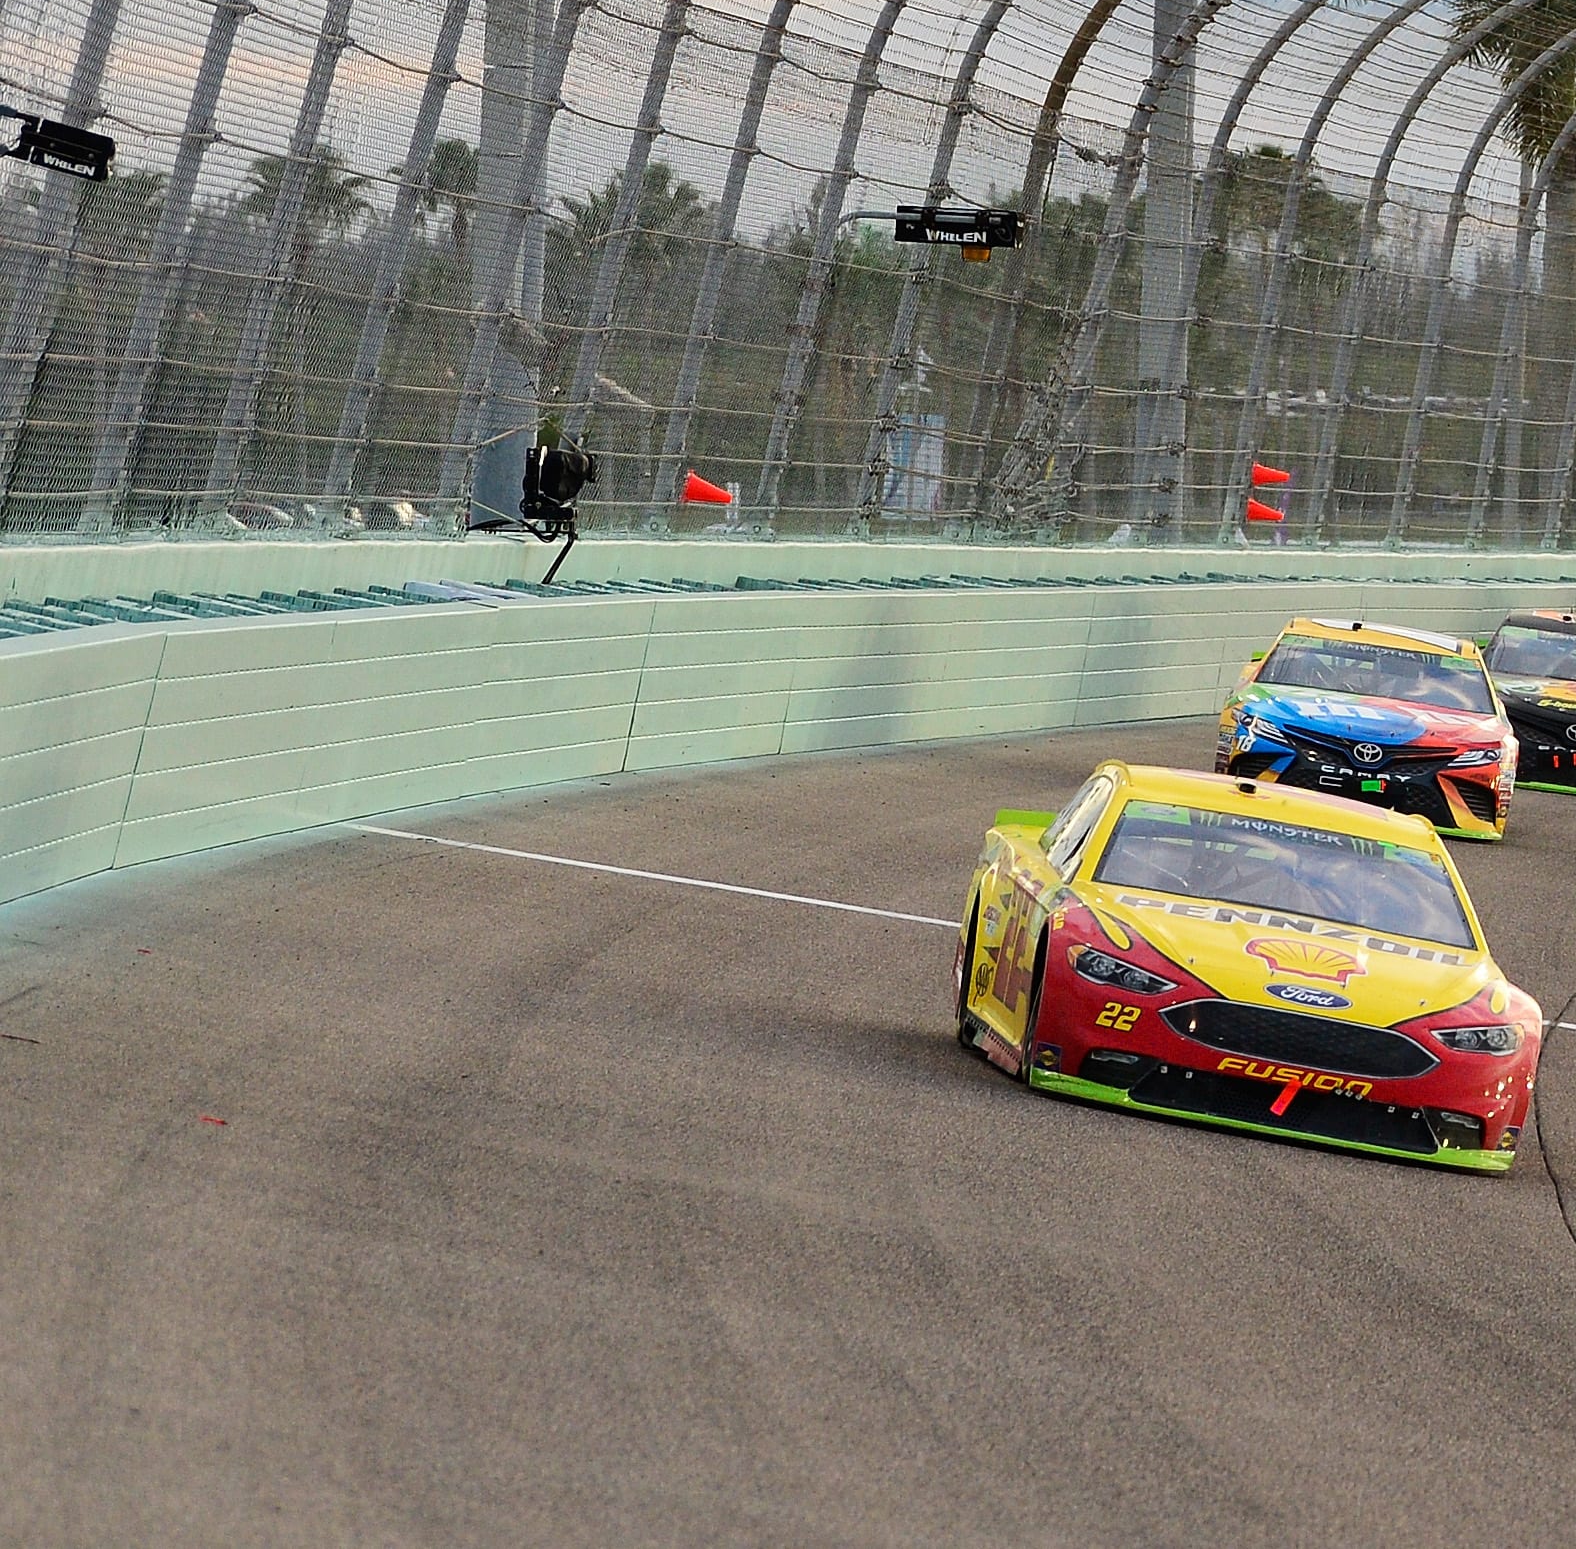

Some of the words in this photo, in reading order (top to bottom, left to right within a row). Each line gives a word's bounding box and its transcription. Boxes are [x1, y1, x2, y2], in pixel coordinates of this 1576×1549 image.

[43, 153, 96, 176] WHELEN
[925, 228, 987, 243] WHELEN
[1236, 734, 1256, 752] 18
[1231, 818, 1344, 847] MONSTER
[1119, 894, 1473, 967] PENNZOIL
[1280, 984, 1334, 1008] Ford
[1095, 1001, 1141, 1032] 22
[1217, 1057, 1374, 1097] FUSION
